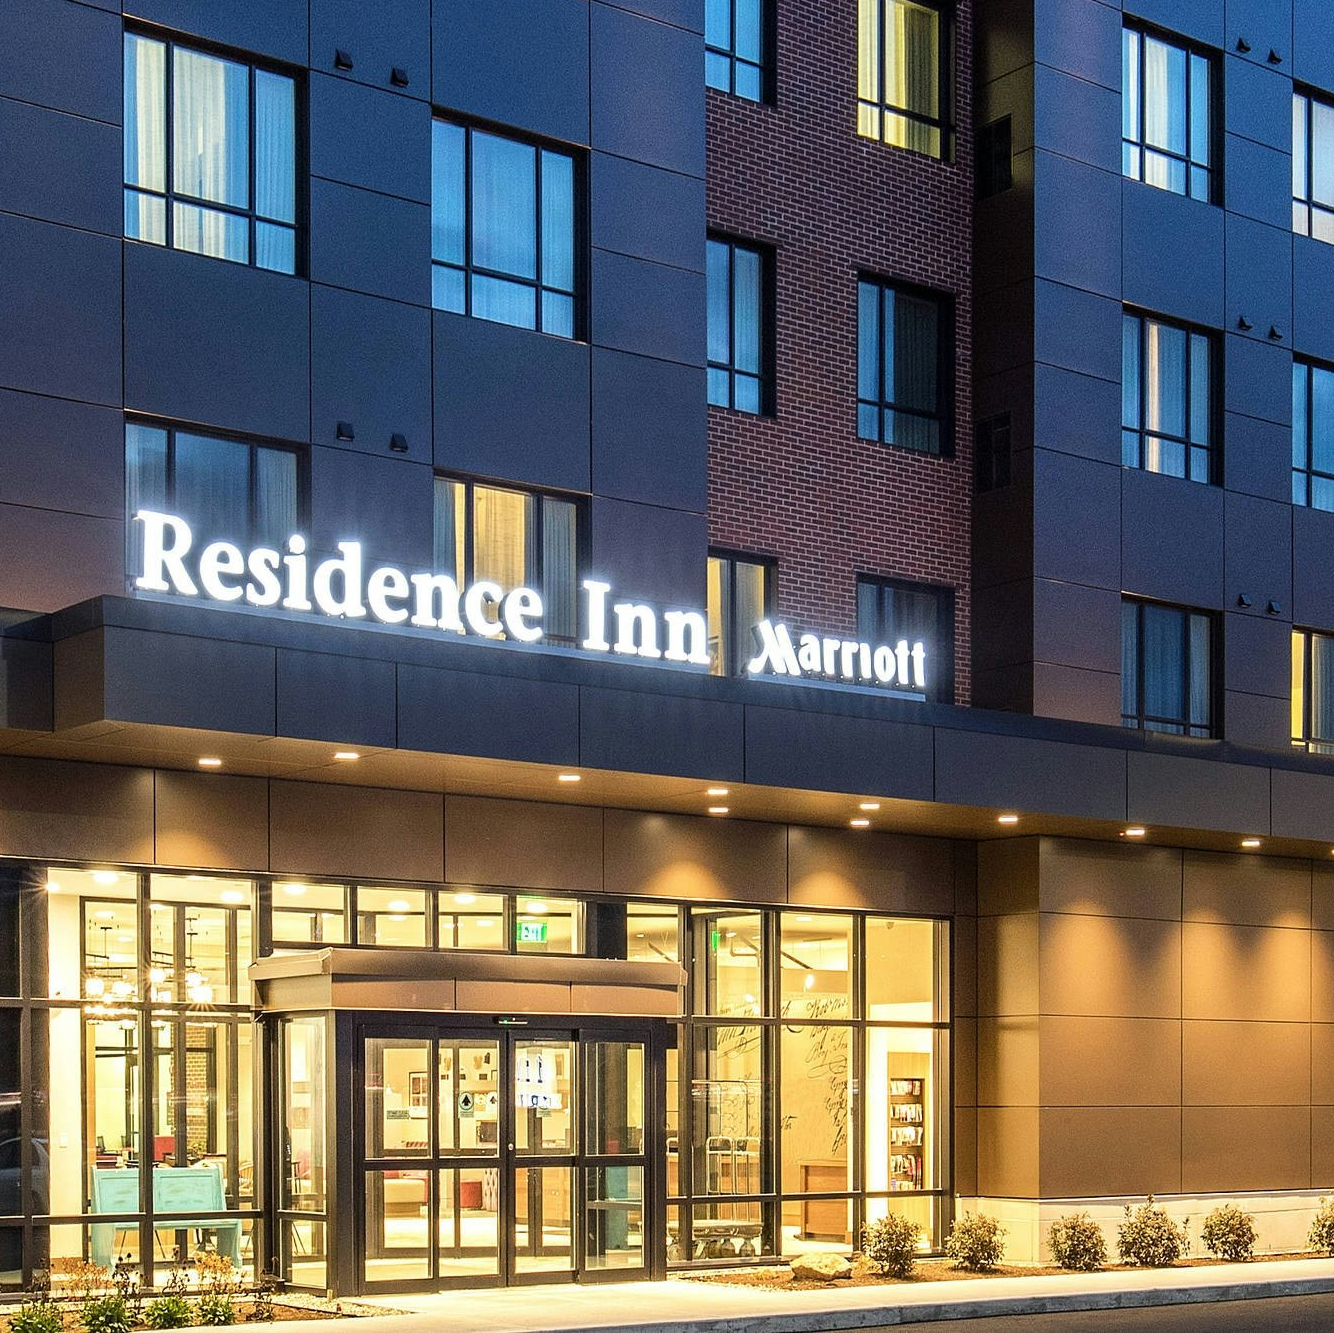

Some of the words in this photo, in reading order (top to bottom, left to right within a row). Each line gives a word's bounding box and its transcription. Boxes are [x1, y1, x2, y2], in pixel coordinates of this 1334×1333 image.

[132, 508, 545, 643] Residence
[581, 579, 712, 666] Inn
[747, 619, 926, 687] Marriott
